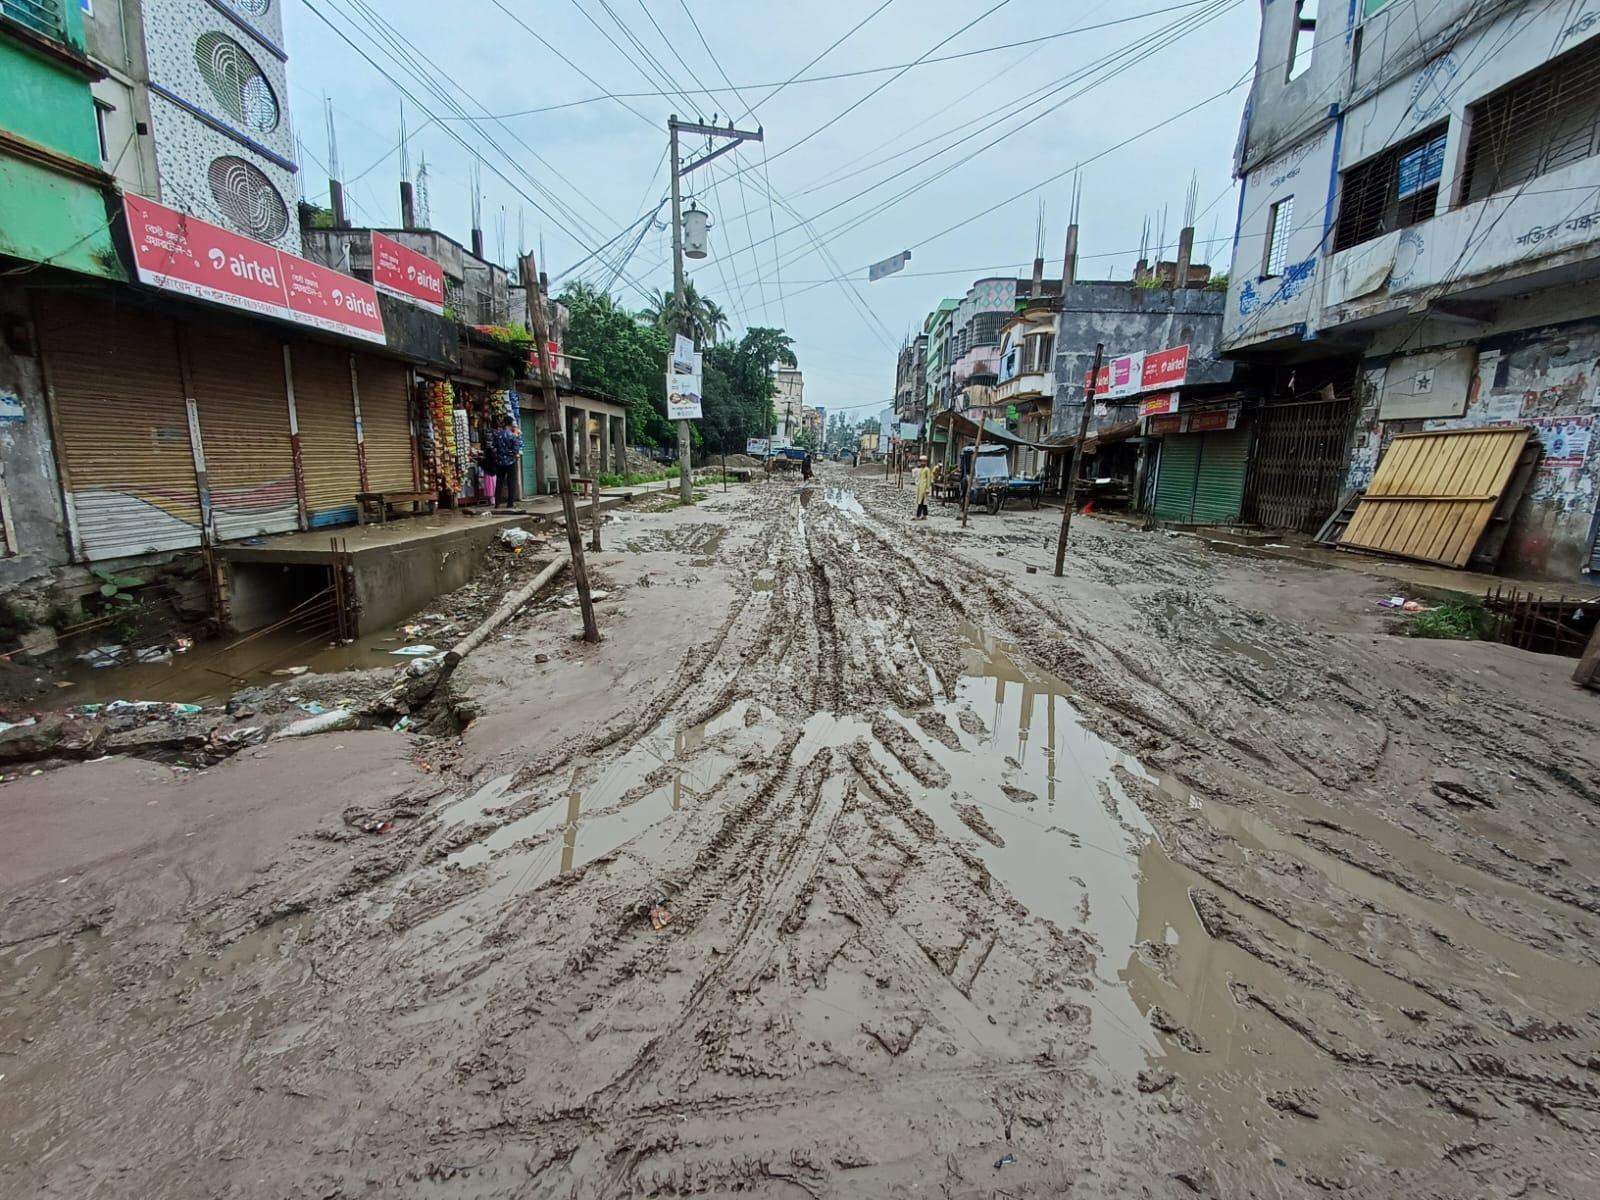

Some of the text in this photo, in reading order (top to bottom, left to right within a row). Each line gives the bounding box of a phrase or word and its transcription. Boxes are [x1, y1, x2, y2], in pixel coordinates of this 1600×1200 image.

[229, 253, 280, 289] airtel
[416, 269, 441, 294] airtel
[345, 290, 379, 320] airtel
[1166, 358, 1184, 372] airtel
